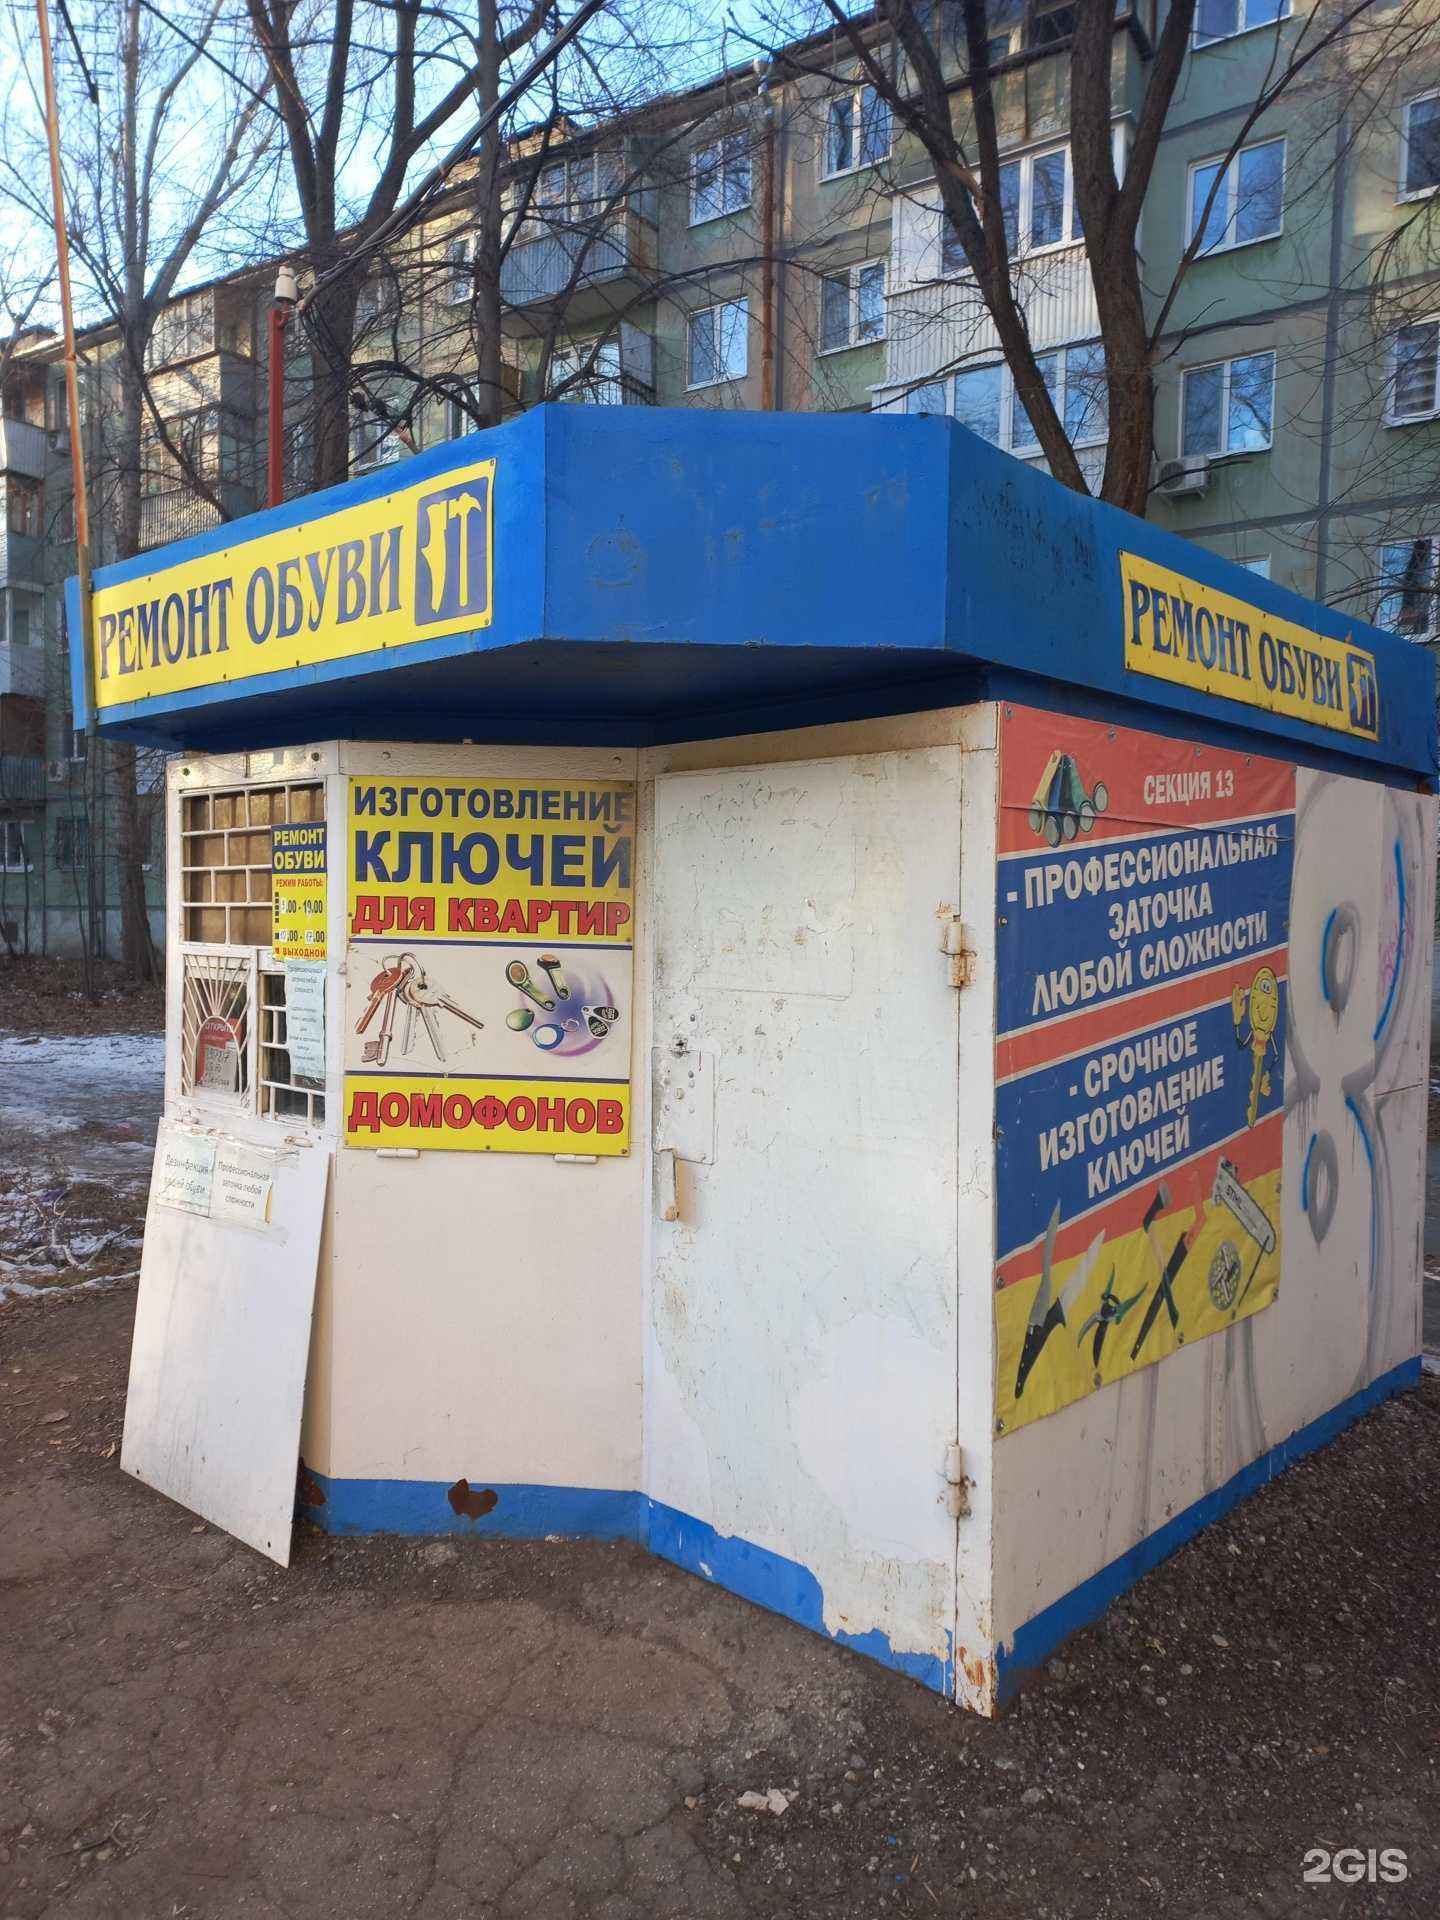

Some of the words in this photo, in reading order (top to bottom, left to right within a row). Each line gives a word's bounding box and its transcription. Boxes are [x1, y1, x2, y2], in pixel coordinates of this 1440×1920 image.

[98, 577, 233, 680] РЕМОНТ
[246, 526, 403, 645] ОБУВИ
[1128, 579, 1251, 680] РЕМОНТ
[1259, 632, 1343, 711] ОБУВИ
[354, 786, 634, 822] ИЗГОТОВЛЕНИЕ
[1143, 771, 1211, 806] СЕКЦИЯ
[1215, 769, 1234, 799] 13
[274, 828, 324, 846] РЕМОНТ
[274, 850, 324, 870] ОБУВИ
[355, 823, 630, 888] КЛЮЧЕЙ
[1024, 823, 1278, 909] ПРОФЕССИОНАЛЬНАЯ
[352, 895, 435, 935] ДЛЯ
[448, 896, 631, 936] КВАРТИР
[1108, 882, 1213, 941] ЗАТОЧКА
[1031, 942, 1132, 1016] ЛЮБОЙ
[1139, 911, 1267, 979] СЛОЖНОСТИ
[1084, 1022, 1198, 1099] СРОЧНОЕ
[348, 1092, 624, 1134] ДОМОФОНОВ
[1039, 1055, 1224, 1172] ИЗГОТОВЛЕНИЕ
[1087, 1108, 1190, 1200] КЛЮЧЕЙ
